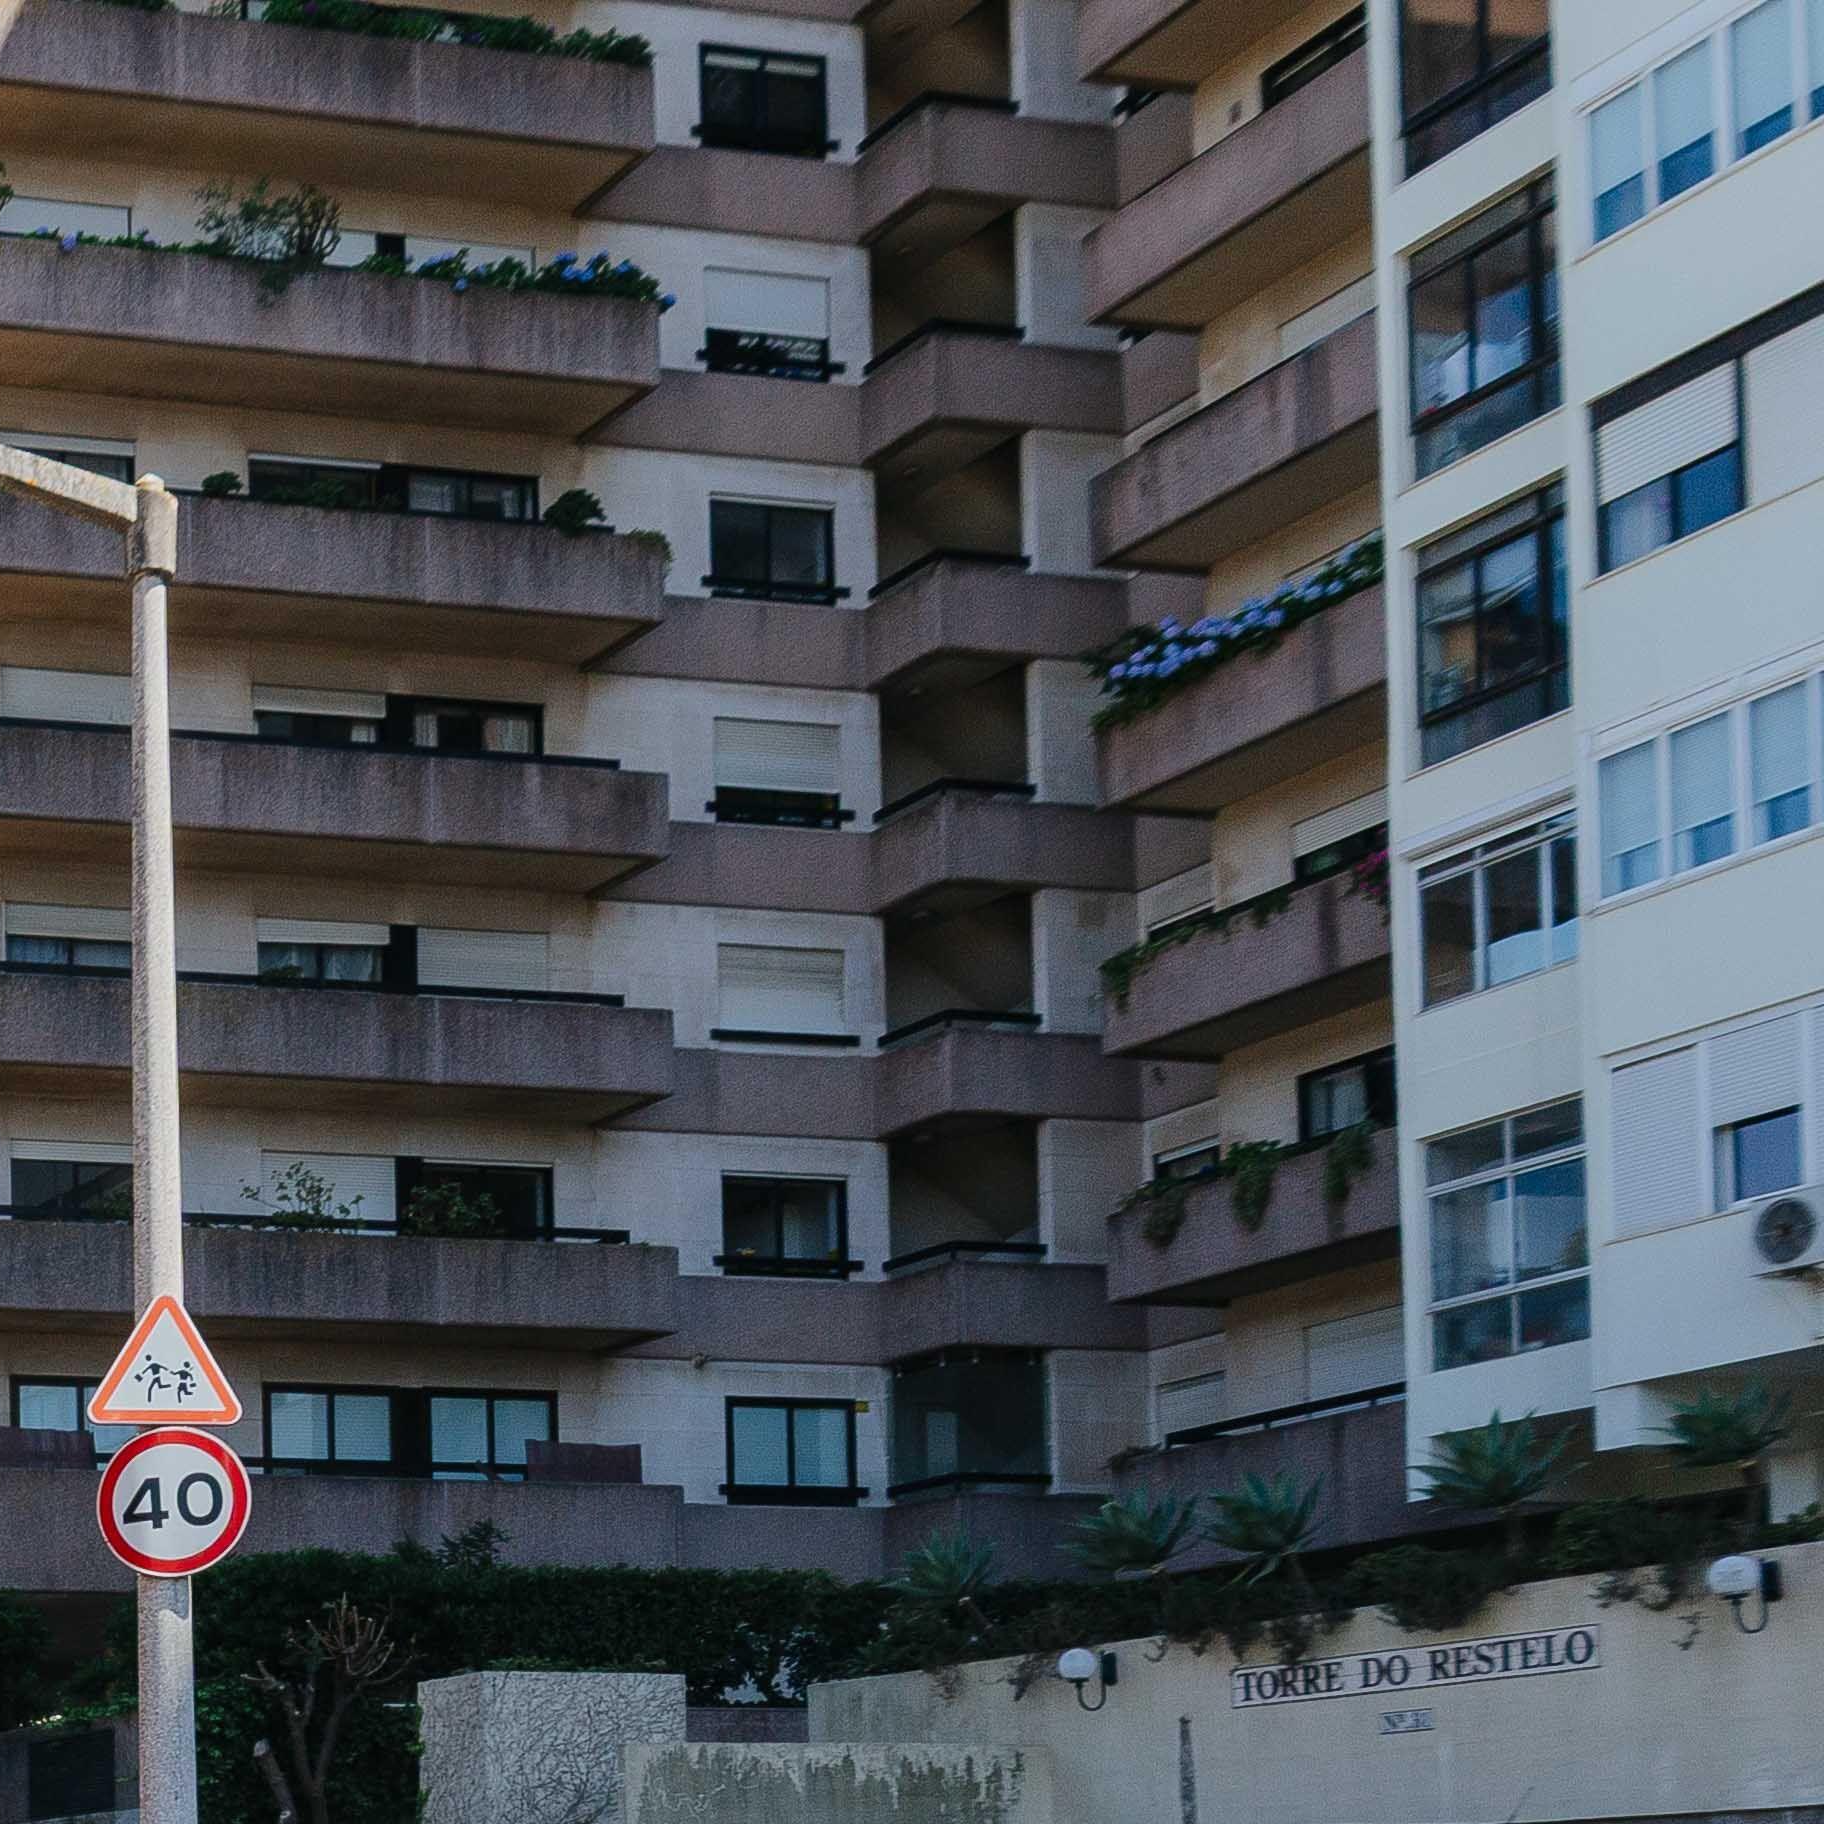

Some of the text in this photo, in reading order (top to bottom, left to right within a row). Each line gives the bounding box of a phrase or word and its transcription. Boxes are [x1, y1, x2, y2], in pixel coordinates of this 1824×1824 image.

[122, 1471, 223, 1530] 40
[1236, 1629, 1595, 1702] TORRE DO RESTELO
